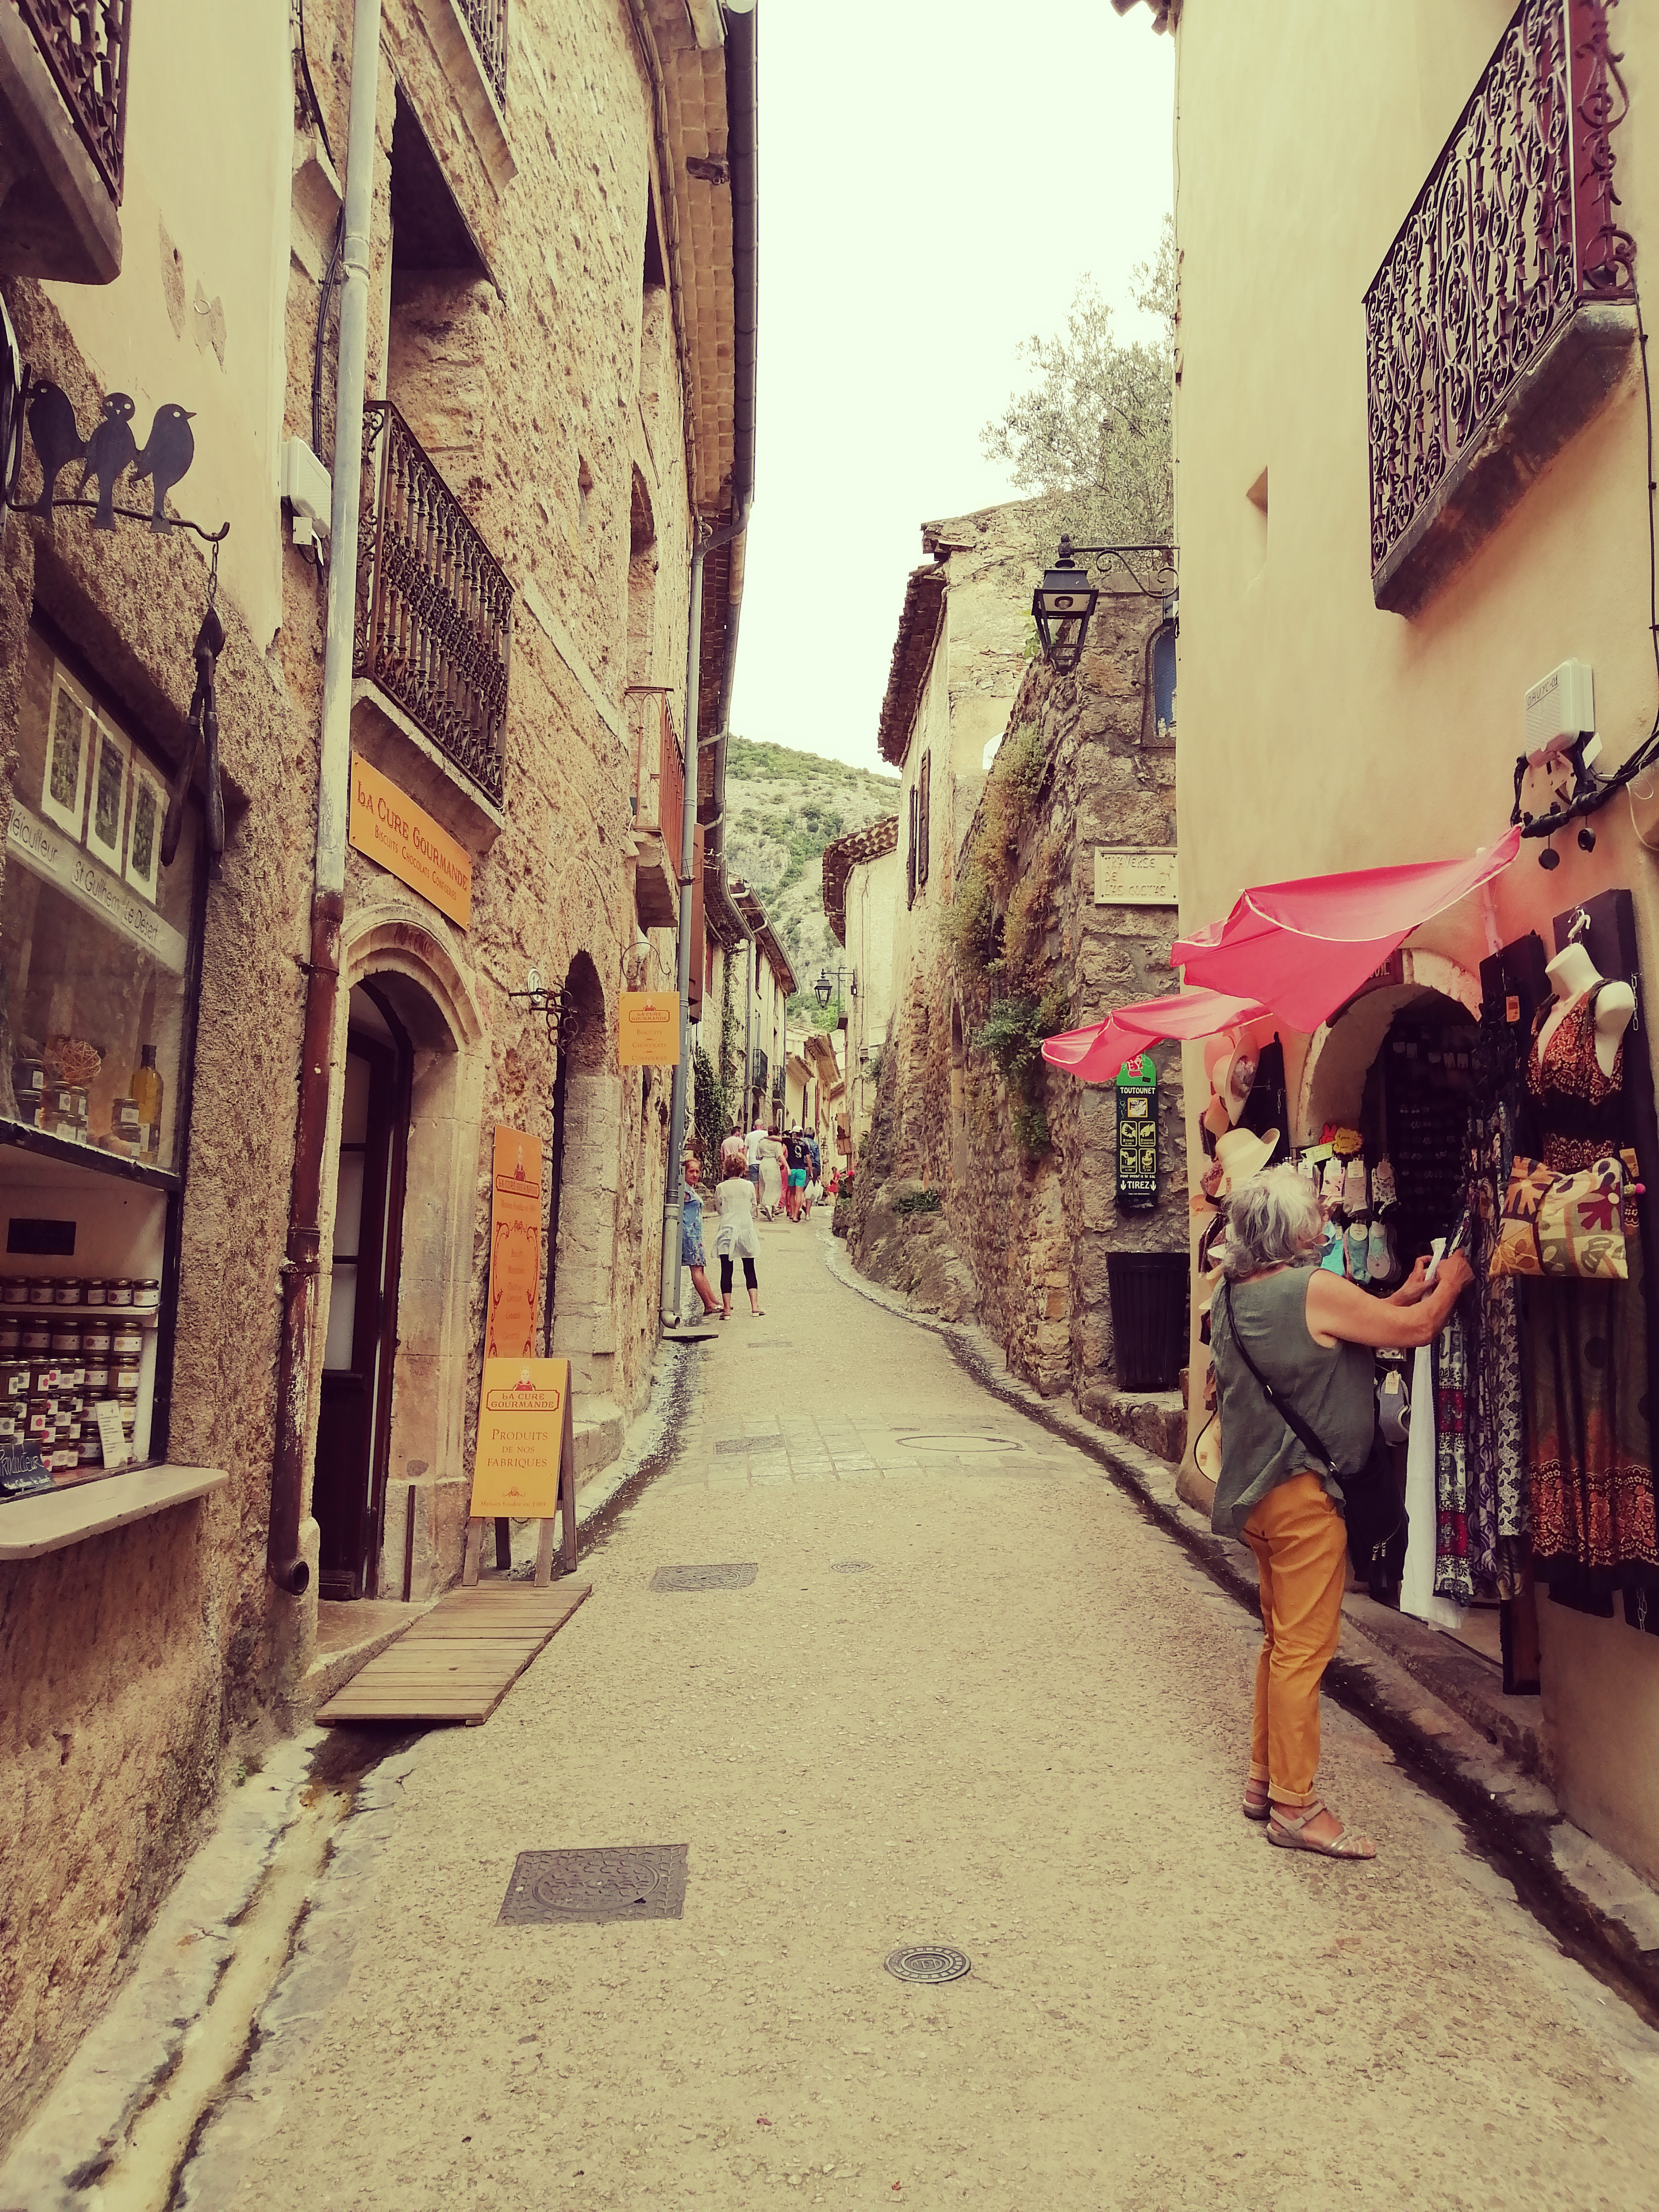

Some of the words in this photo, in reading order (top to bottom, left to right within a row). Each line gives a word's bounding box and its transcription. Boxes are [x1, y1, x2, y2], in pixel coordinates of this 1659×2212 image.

[357, 780, 374, 815] LA
[378, 798, 409, 841] CURE
[413, 827, 468, 891] GOURMANDE
[375, 824, 398, 853] BISCUITS
[402, 846, 430, 878] CHOCOLATS
[433, 871, 457, 901] CONFISERIES
[1105, 855, 1155, 868] TRAVERSE
[1105, 871, 1117, 882] DE
[1105, 884, 1124, 896] LAS
[1129, 885, 1166, 896] COSTAS
[74, 861, 83, 883] St
[86, 870, 120, 914] Guilhem
[134, 909, 158, 942] Désert
[794, 1145, 802, 1158] 9
[1127, 1181, 1149, 1189] TIREZ
[492, 1429, 548, 1440] PRODUITS
[488, 1458, 547, 1468] FABRIQUES
